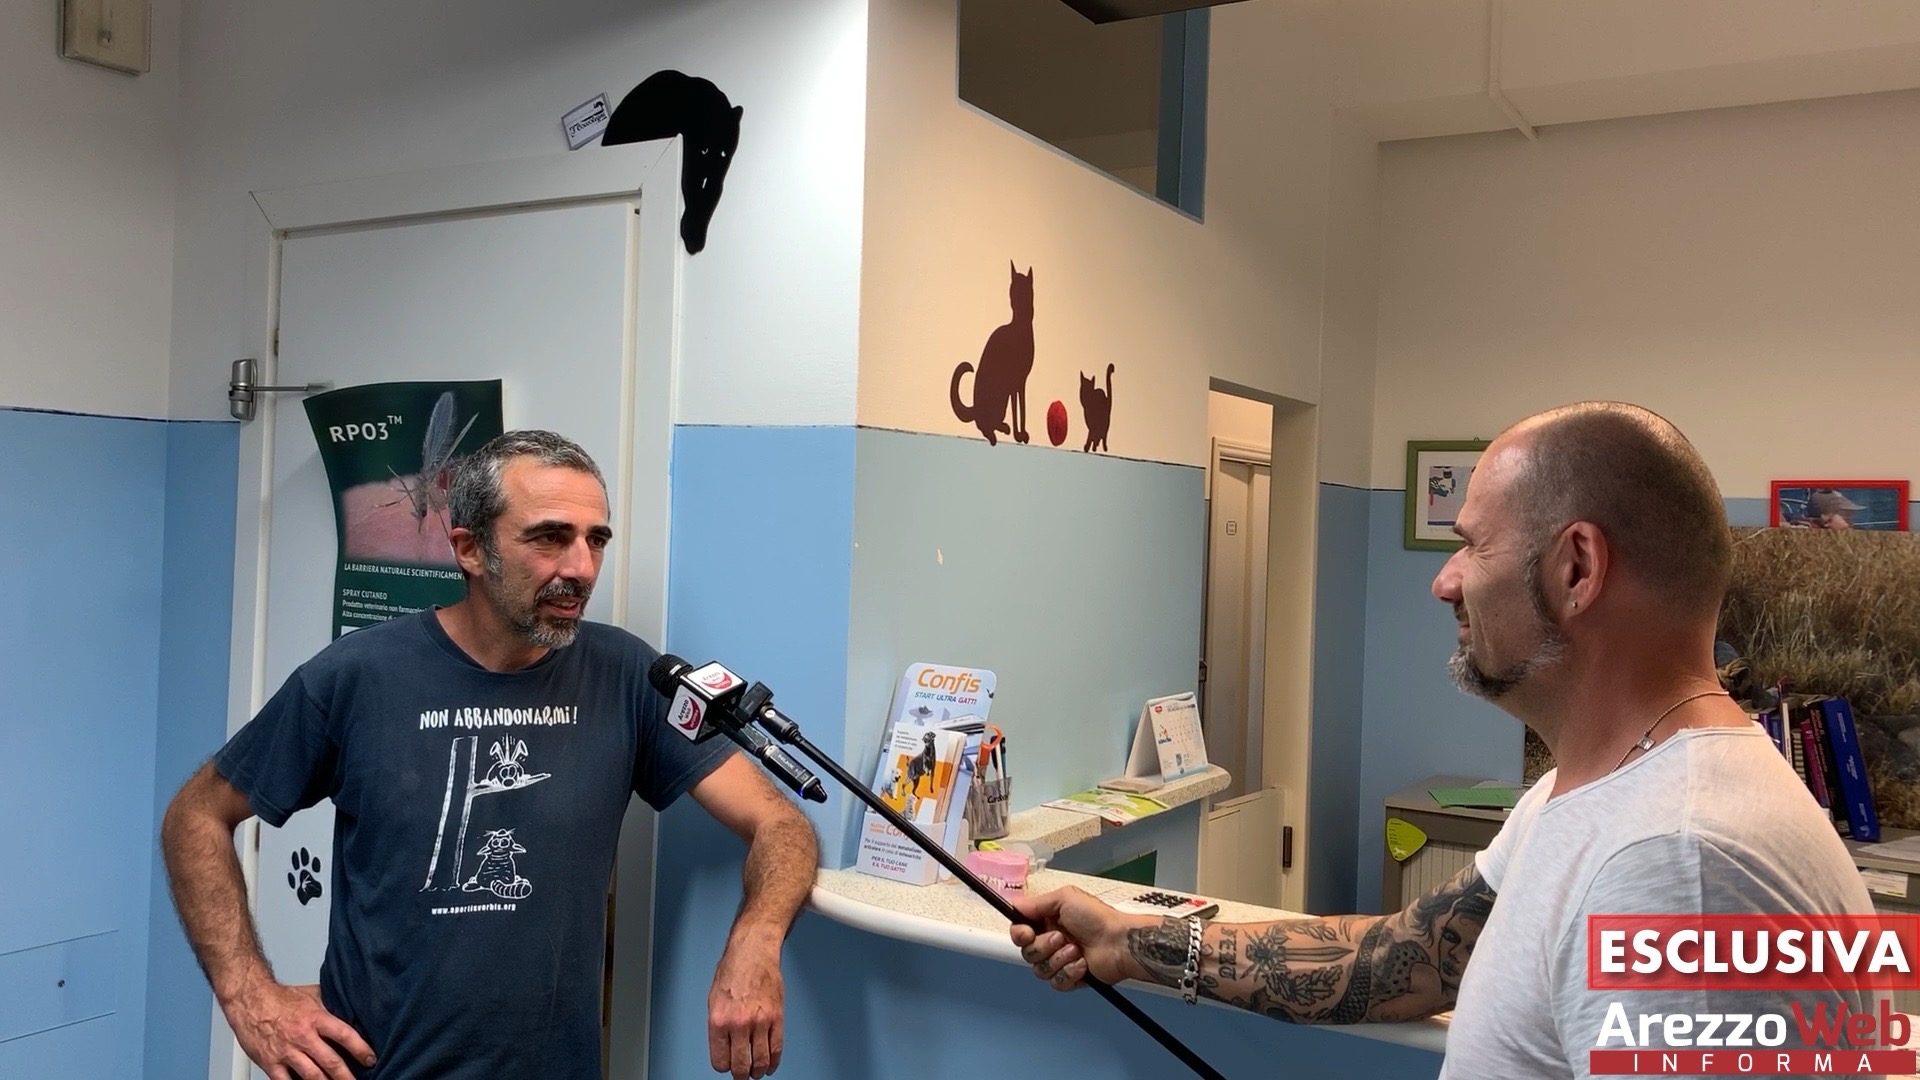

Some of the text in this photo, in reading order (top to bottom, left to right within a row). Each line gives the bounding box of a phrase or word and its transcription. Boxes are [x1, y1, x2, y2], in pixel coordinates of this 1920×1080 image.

[344, 563, 352, 571] LA
[351, 563, 379, 573] BARRIERA
[380, 566, 411, 576] NATURALE
[342, 588, 388, 600] SPRAY CUTANEO
[917, 668, 982, 695] Confis
[914, 691, 978, 705] START ULTRA GATTI
[419, 709, 449, 730] NON
